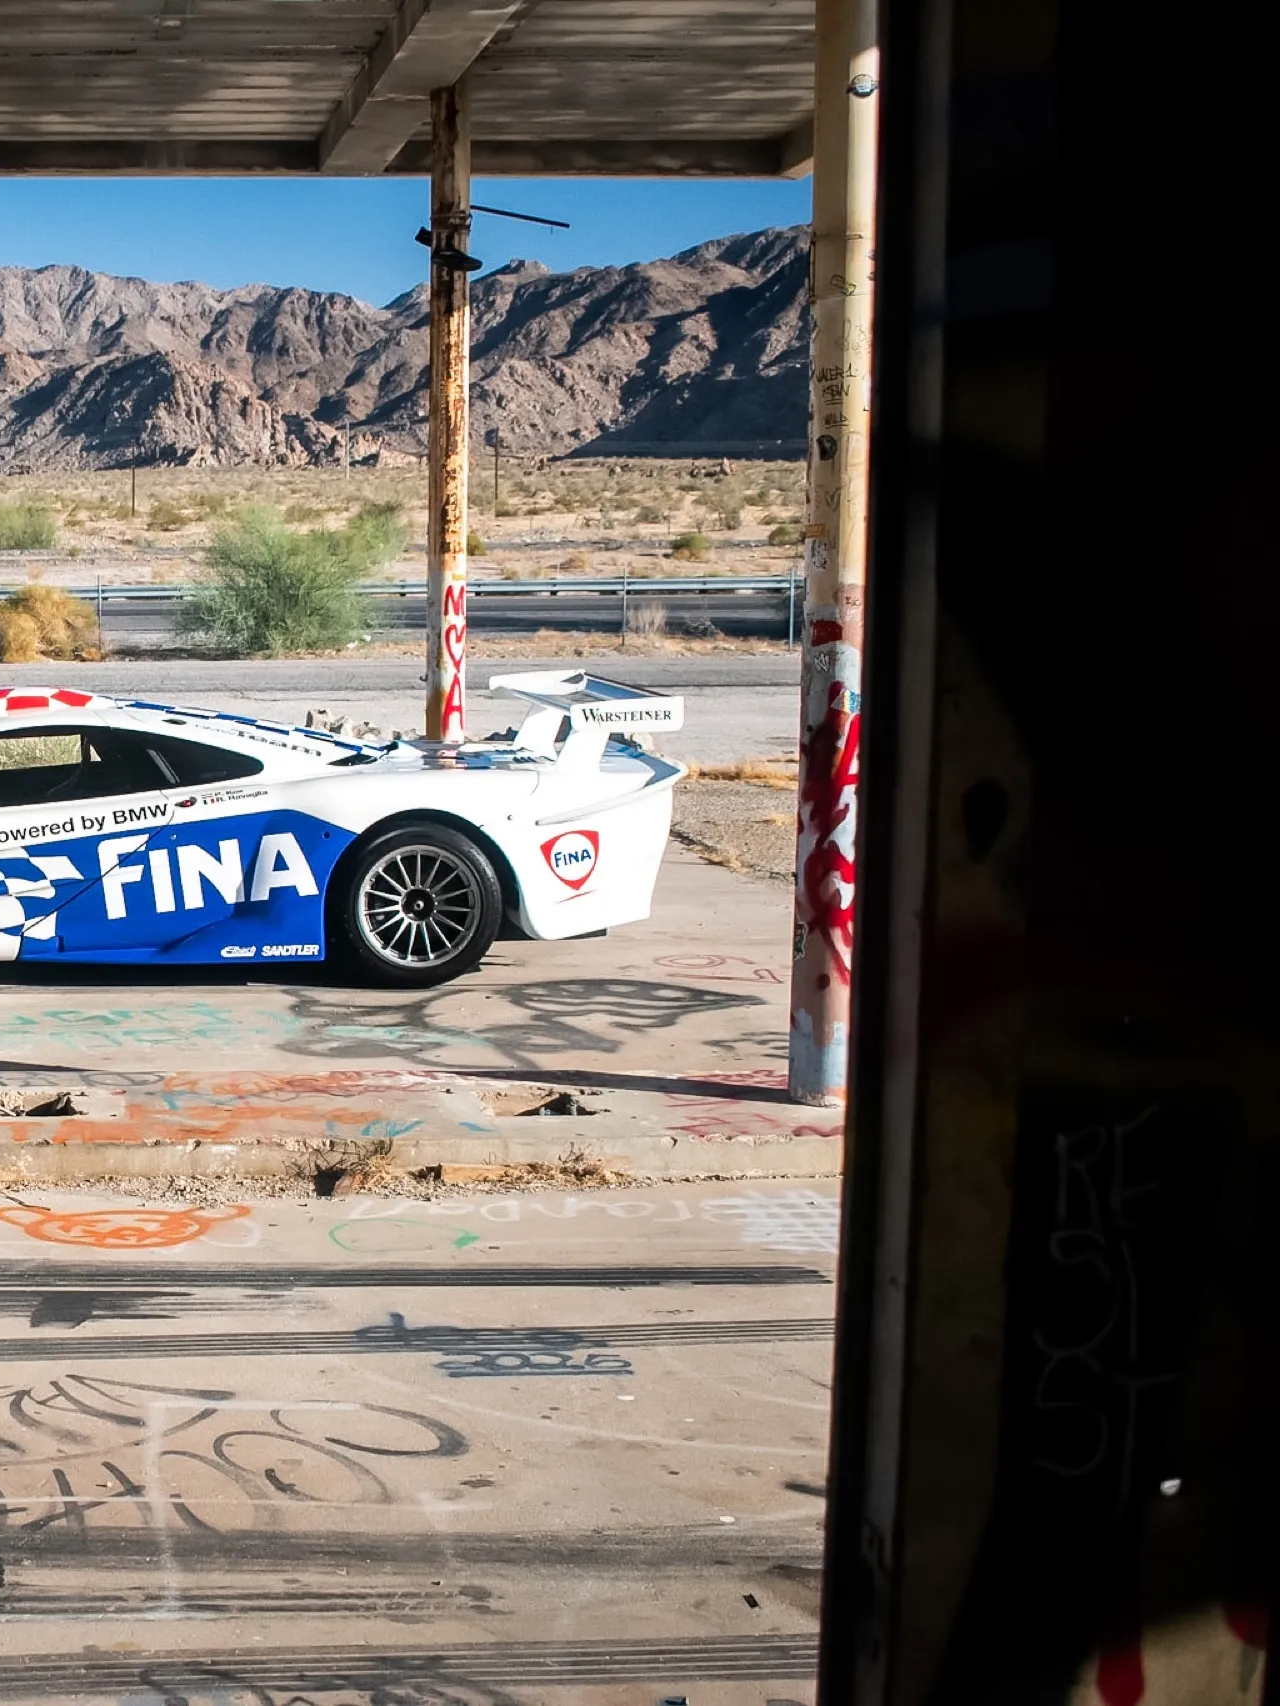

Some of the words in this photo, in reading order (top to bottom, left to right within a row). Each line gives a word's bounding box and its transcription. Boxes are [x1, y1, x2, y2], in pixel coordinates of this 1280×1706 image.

[581, 707, 672, 726] WARSTEINER
[81, 810, 106, 832] by
[113, 803, 169, 825] BMW
[554, 848, 592, 868] FINA
[97, 832, 319, 920] FINA
[261, 945, 320, 957] SANDTLER
